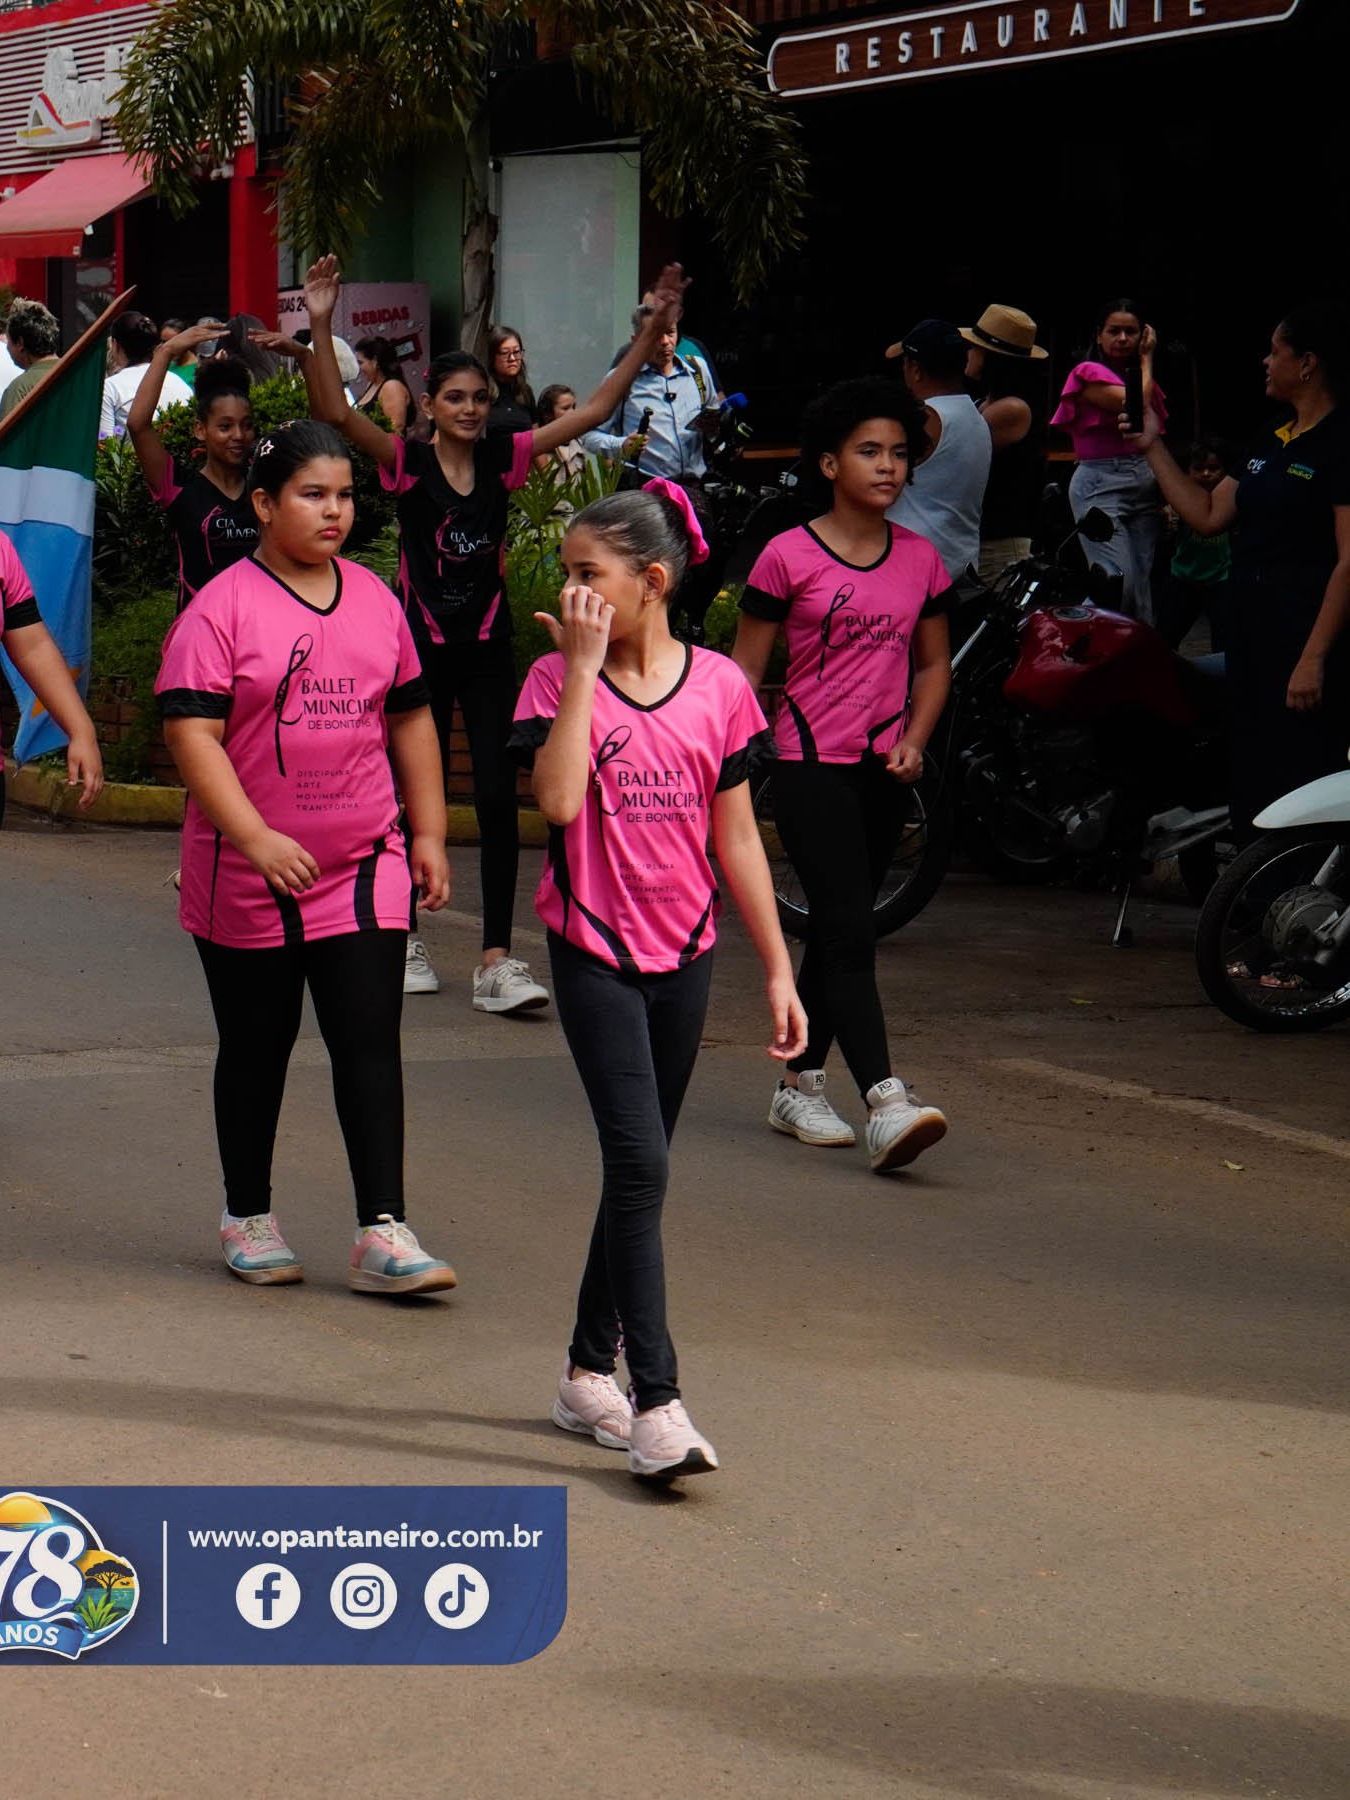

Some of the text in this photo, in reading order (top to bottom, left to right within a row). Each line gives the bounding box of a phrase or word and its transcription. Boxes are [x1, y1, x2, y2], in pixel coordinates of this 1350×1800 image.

[835, 0, 1206, 74] RESTAURANTE
[352, 306, 410, 326] BEBIDAS
[216, 518, 236, 529] CIA
[846, 614, 893, 627] BALLET
[301, 678, 356, 694] BALLET
[308, 720, 322, 730] DE
[324, 719, 361, 729] BONITO
[618, 771, 683, 787] BALLET
[296, 803, 359, 811] TRANSFORMA
[626, 813, 642, 823] DE
[646, 813, 687, 823] BONITO
